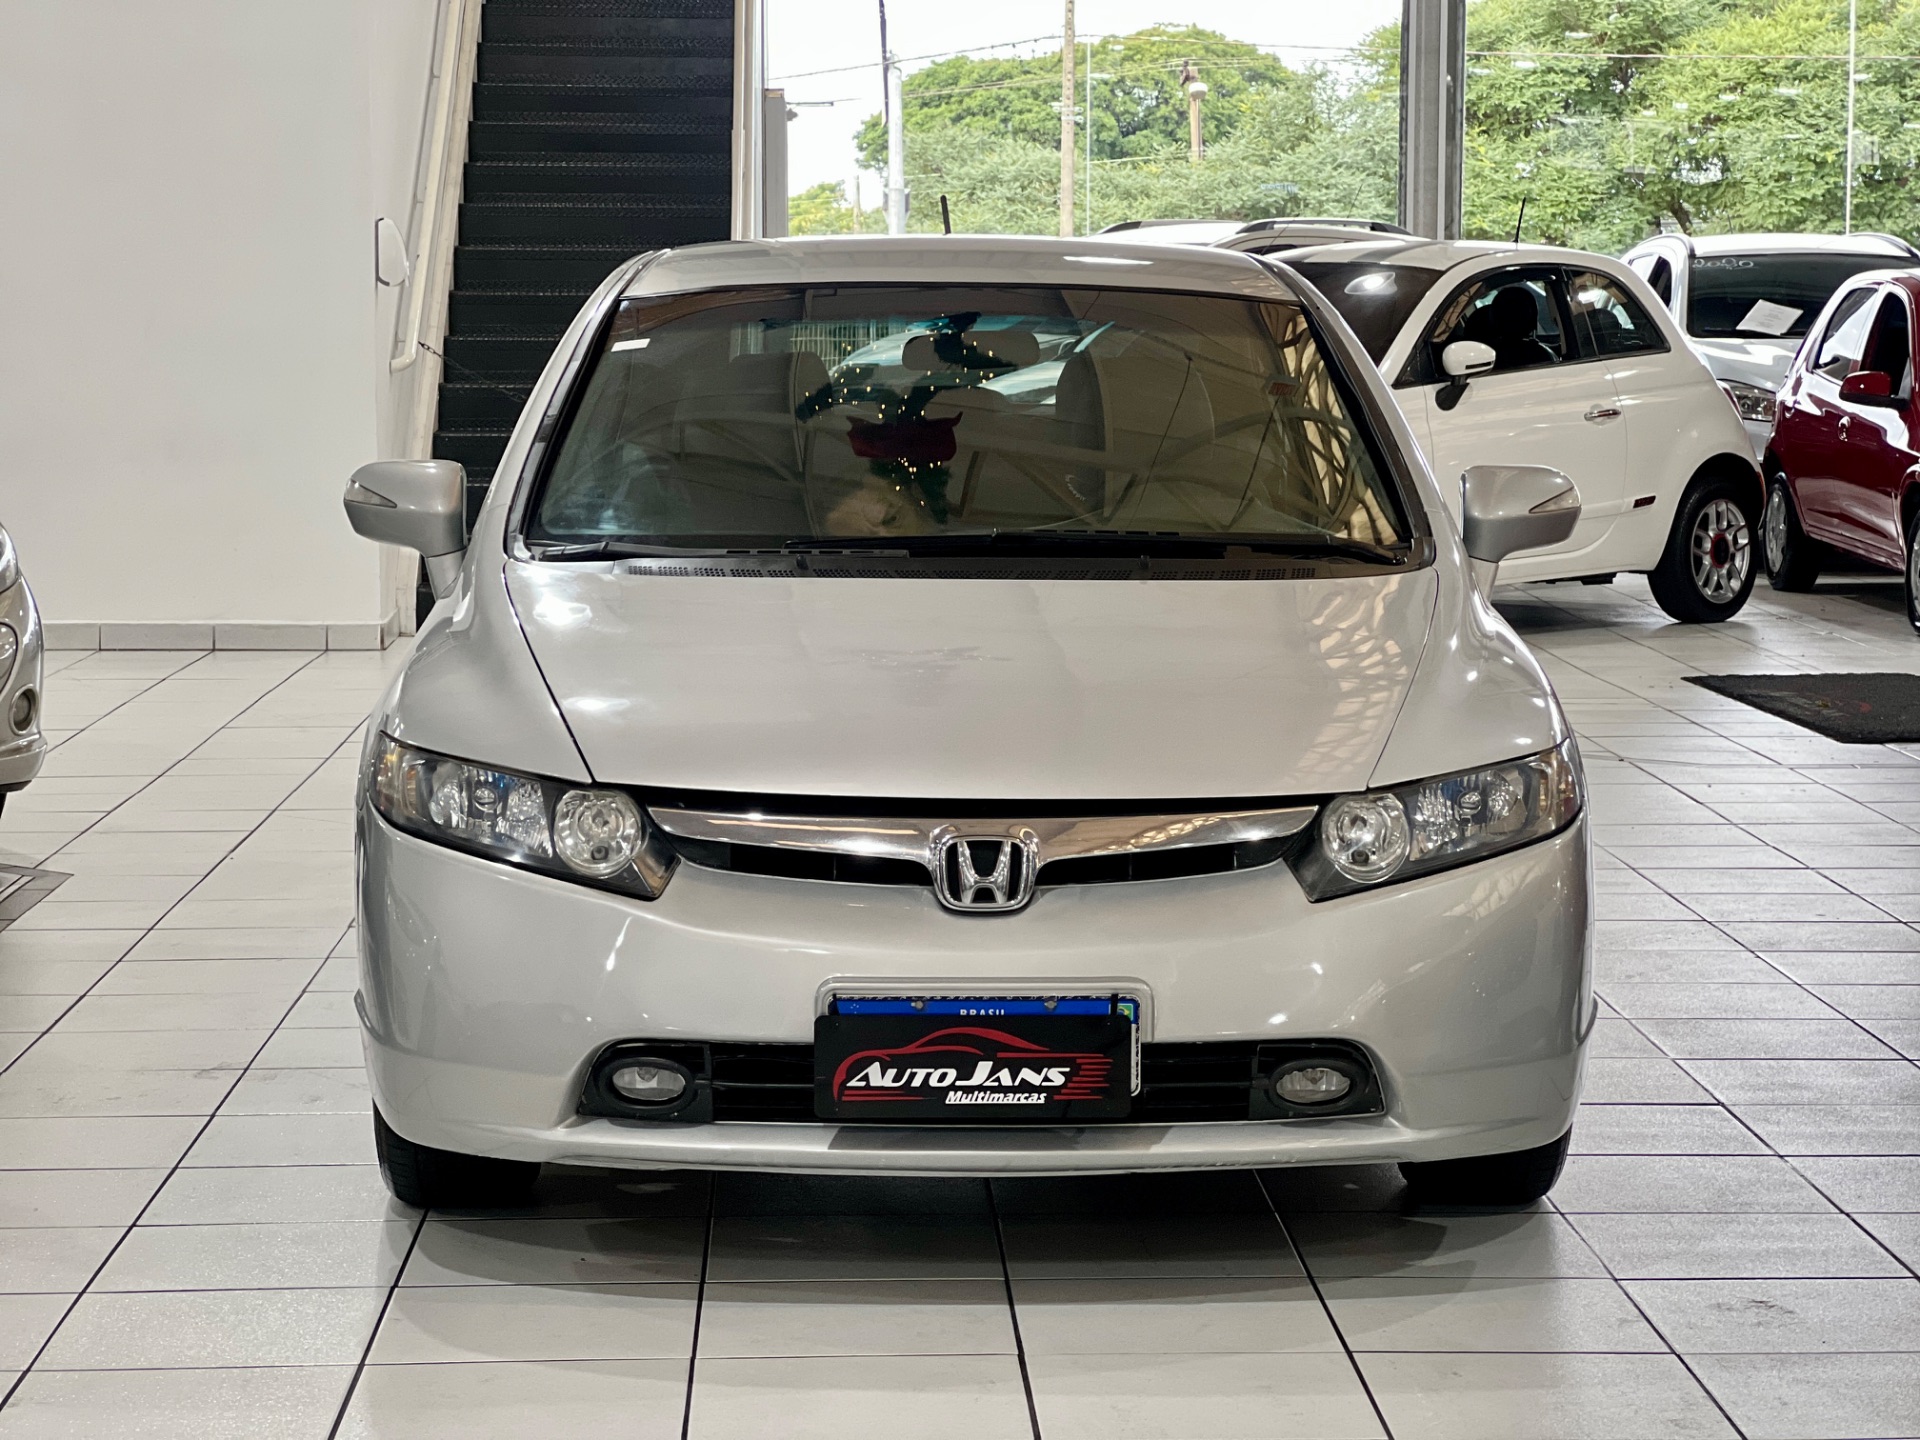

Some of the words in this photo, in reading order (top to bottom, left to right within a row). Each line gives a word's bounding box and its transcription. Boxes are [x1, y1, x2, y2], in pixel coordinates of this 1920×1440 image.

[846, 1061, 957, 1088] AUTO
[955, 1061, 1071, 1087] JANS
[945, 1090, 1048, 1104] Multimarcas
